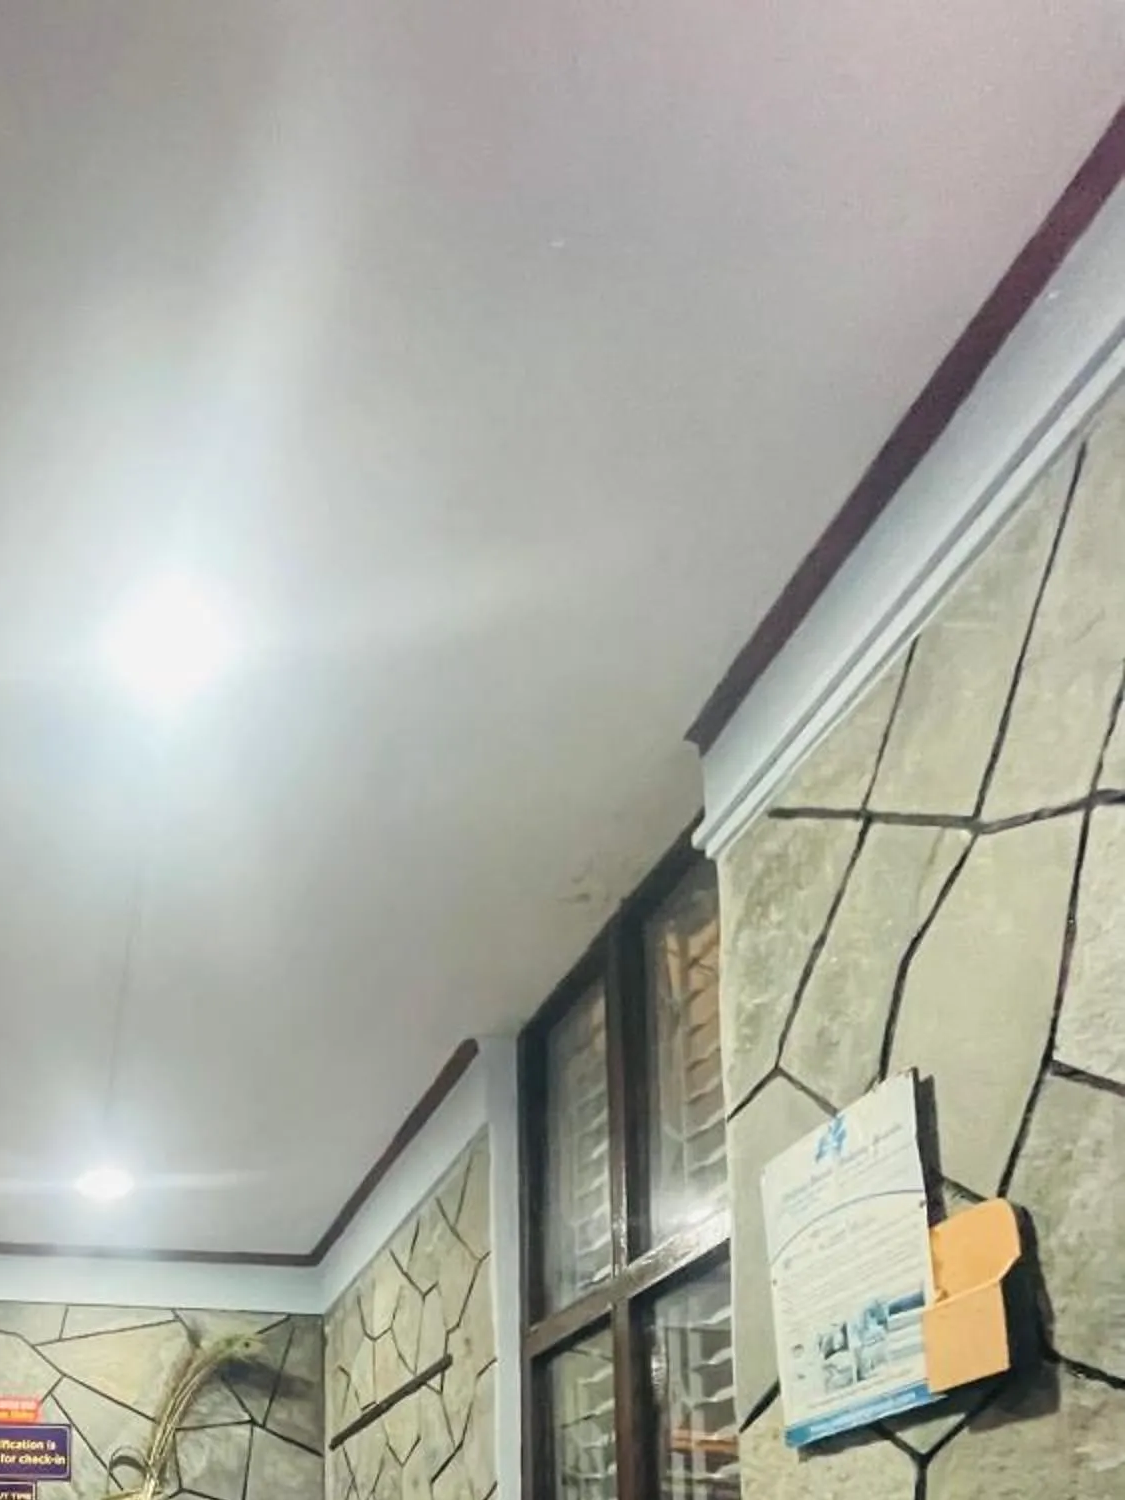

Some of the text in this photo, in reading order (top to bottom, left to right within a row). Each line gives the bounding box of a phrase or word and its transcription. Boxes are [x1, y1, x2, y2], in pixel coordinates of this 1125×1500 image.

[46, 1440, 56, 1450] is
[0, 1453, 16, 1463] for
[18, 1453, 66, 1465] check-in
[11, 1493, 32, 1500] TIME
